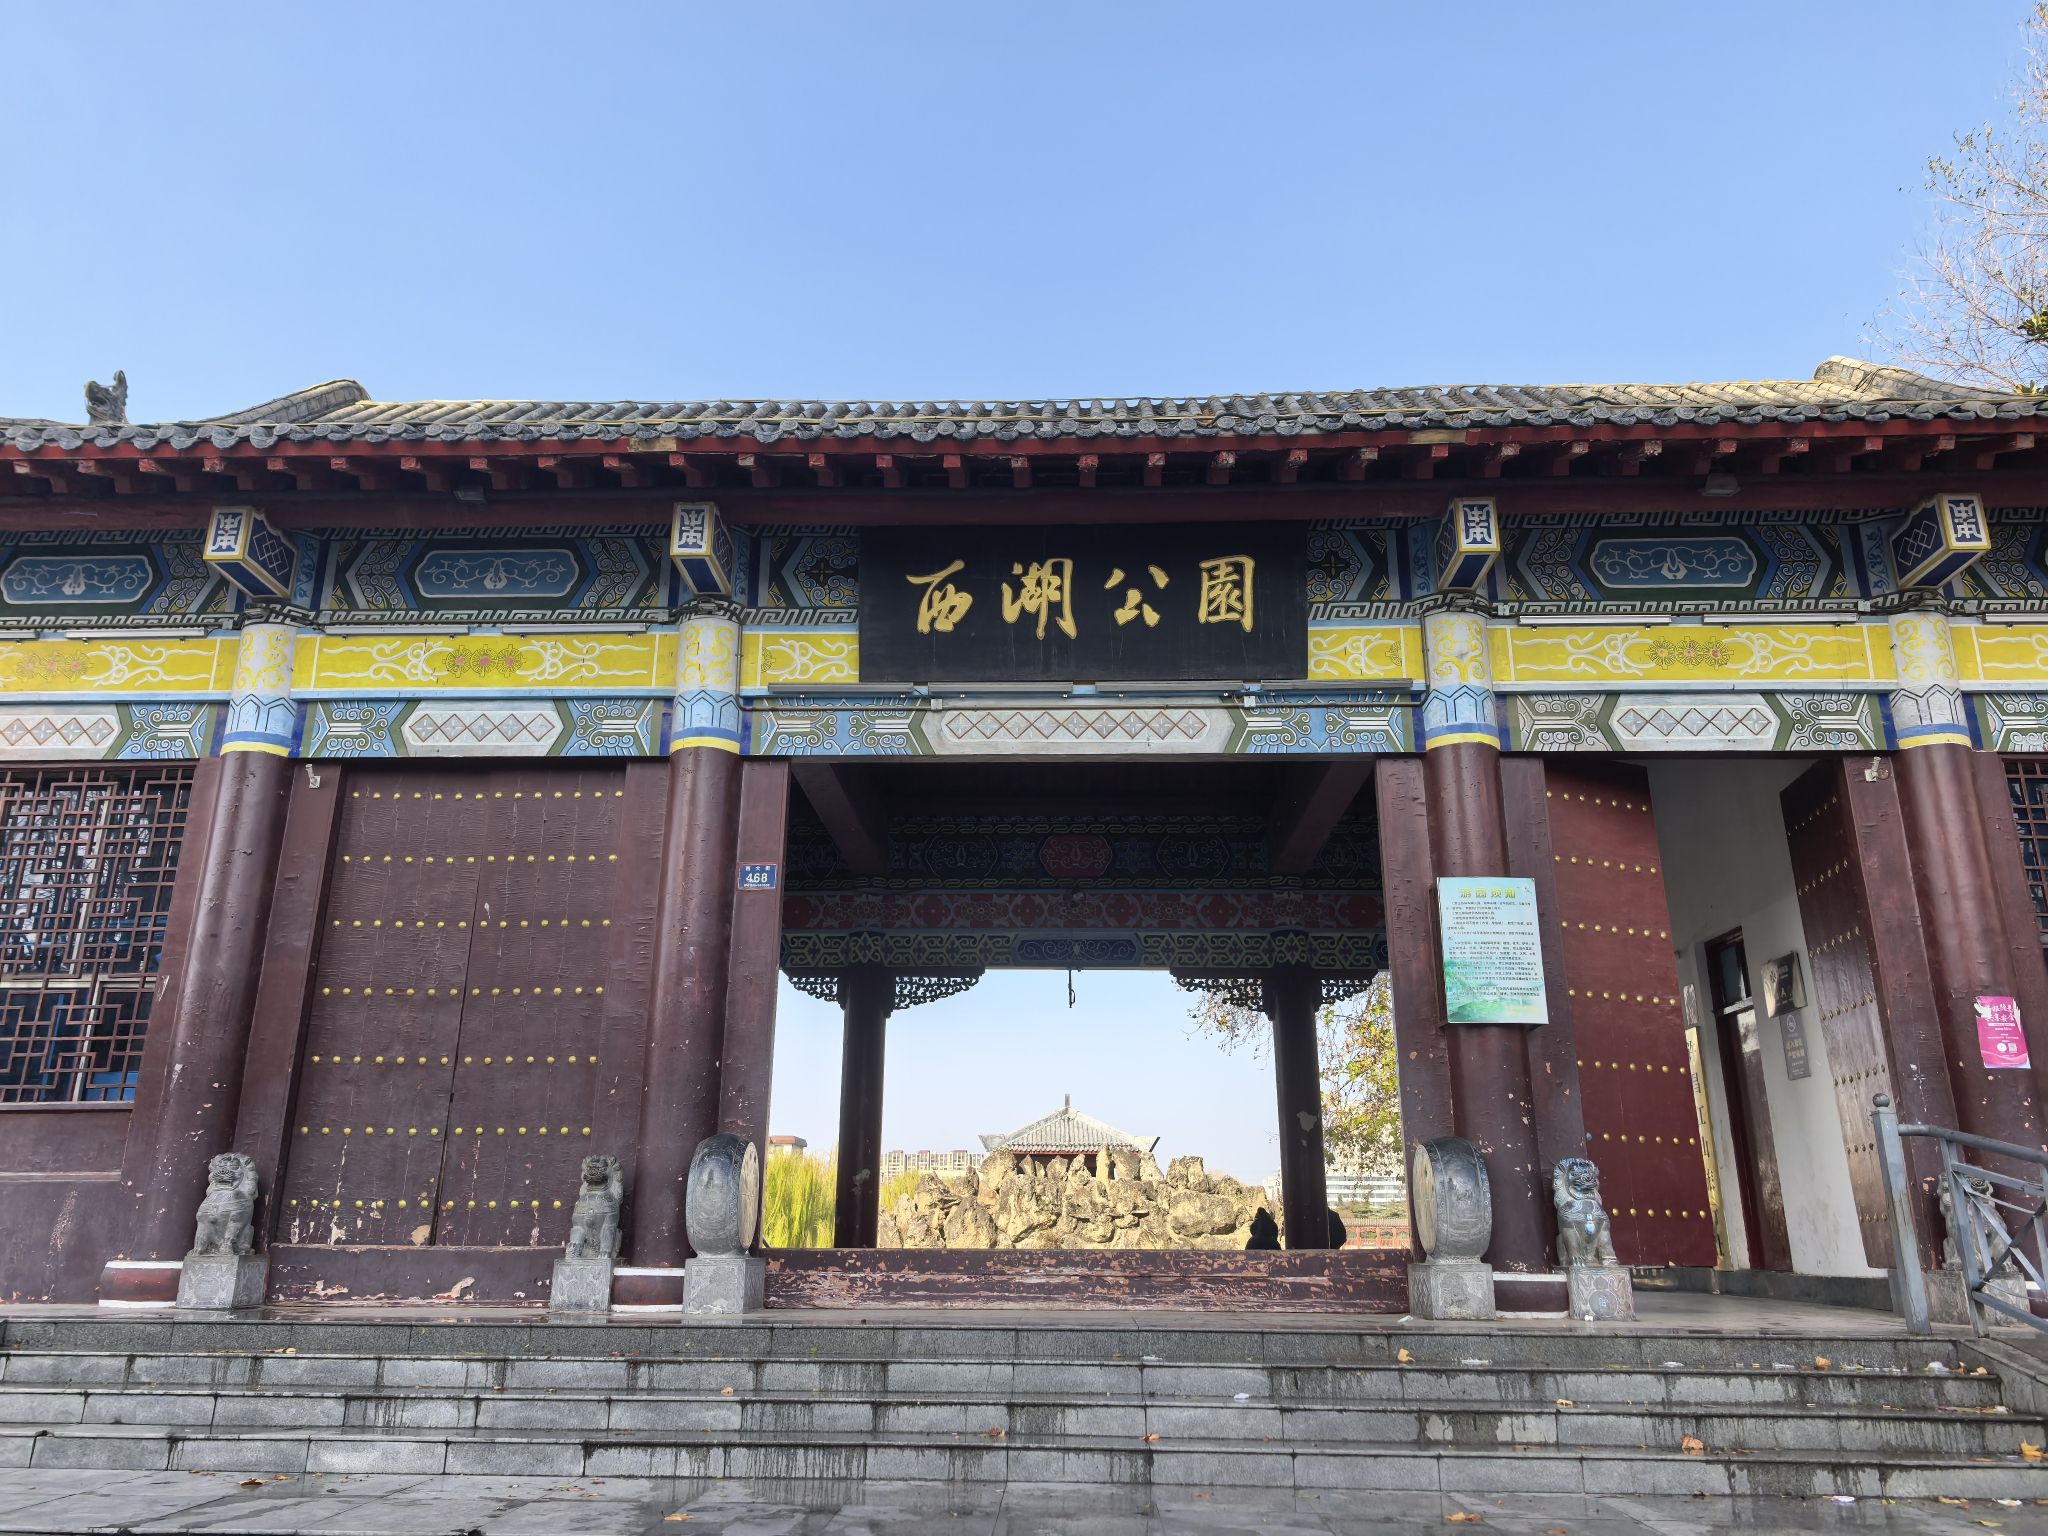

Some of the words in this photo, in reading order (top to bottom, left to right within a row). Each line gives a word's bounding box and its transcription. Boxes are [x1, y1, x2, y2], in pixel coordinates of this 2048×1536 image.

[905, 554, 1255, 640] 西湖公園
[745, 872, 768, 883] 468
